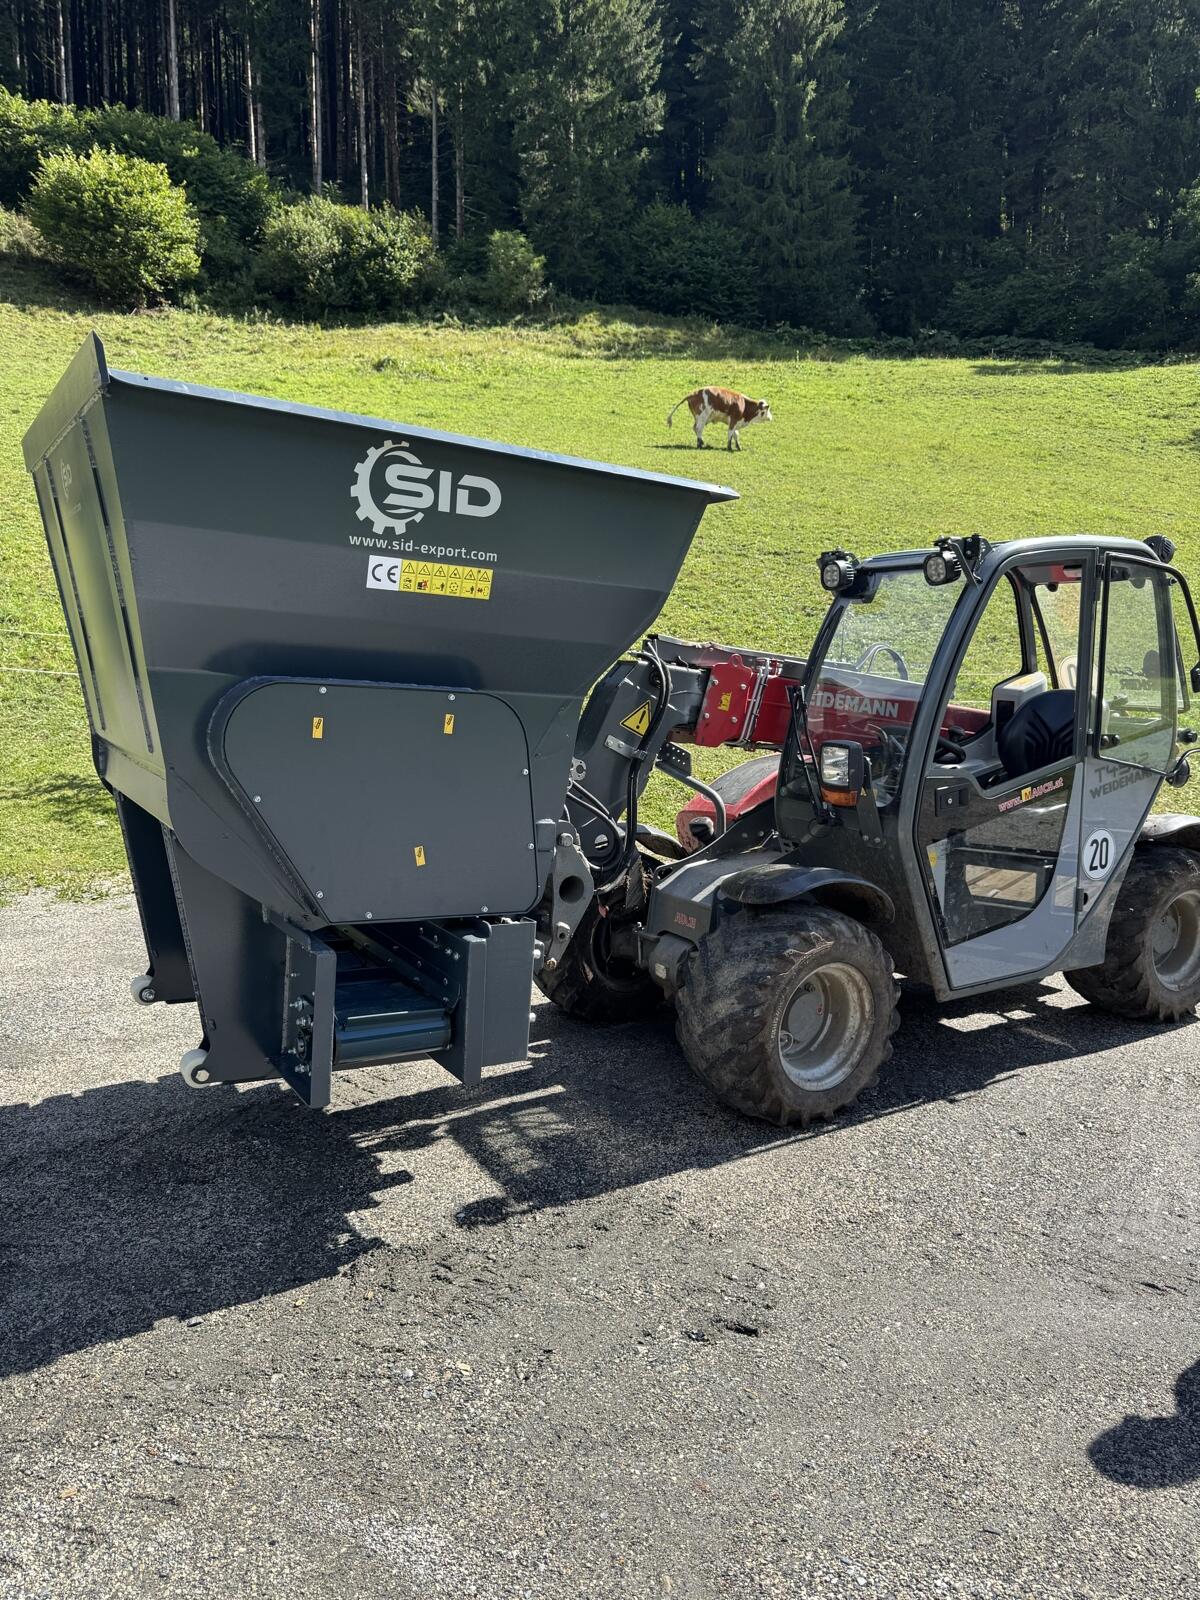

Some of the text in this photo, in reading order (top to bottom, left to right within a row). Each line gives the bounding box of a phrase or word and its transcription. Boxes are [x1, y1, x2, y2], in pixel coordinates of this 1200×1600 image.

[382, 463, 502, 518] SID
[349, 535, 498, 562] www.sid-export.com
[371, 563, 399, 584] CE
[808, 690, 900, 718] EIDEMANN
[1089, 838, 1109, 871] 20
